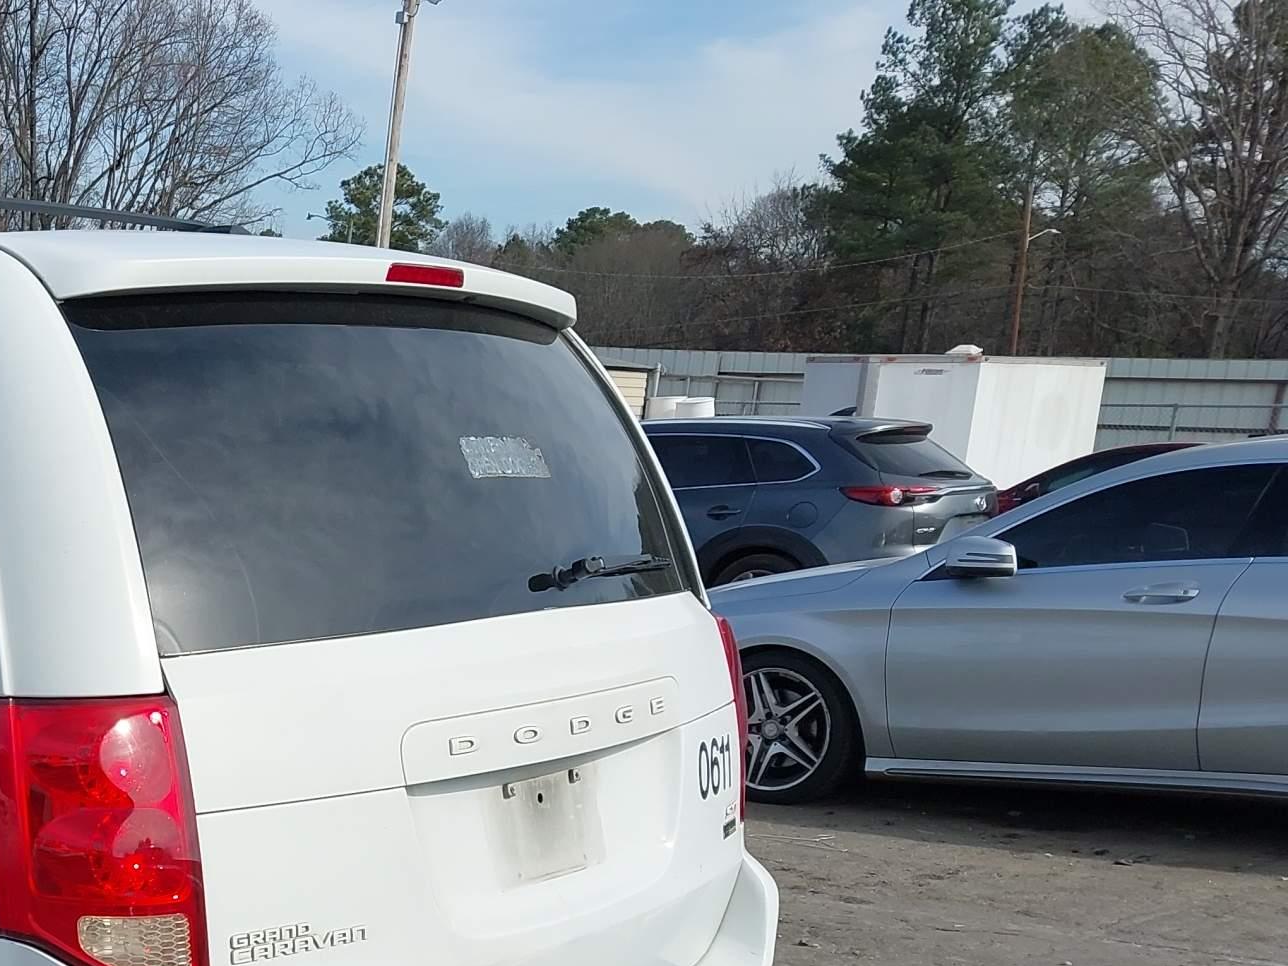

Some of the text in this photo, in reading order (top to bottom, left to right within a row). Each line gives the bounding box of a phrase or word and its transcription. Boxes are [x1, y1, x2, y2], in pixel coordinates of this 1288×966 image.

[448, 696, 666, 756] DODGE
[698, 733, 732, 800] 0611
[229, 922, 312, 950] GRAND
[230, 924, 368, 966] CARAVAN
